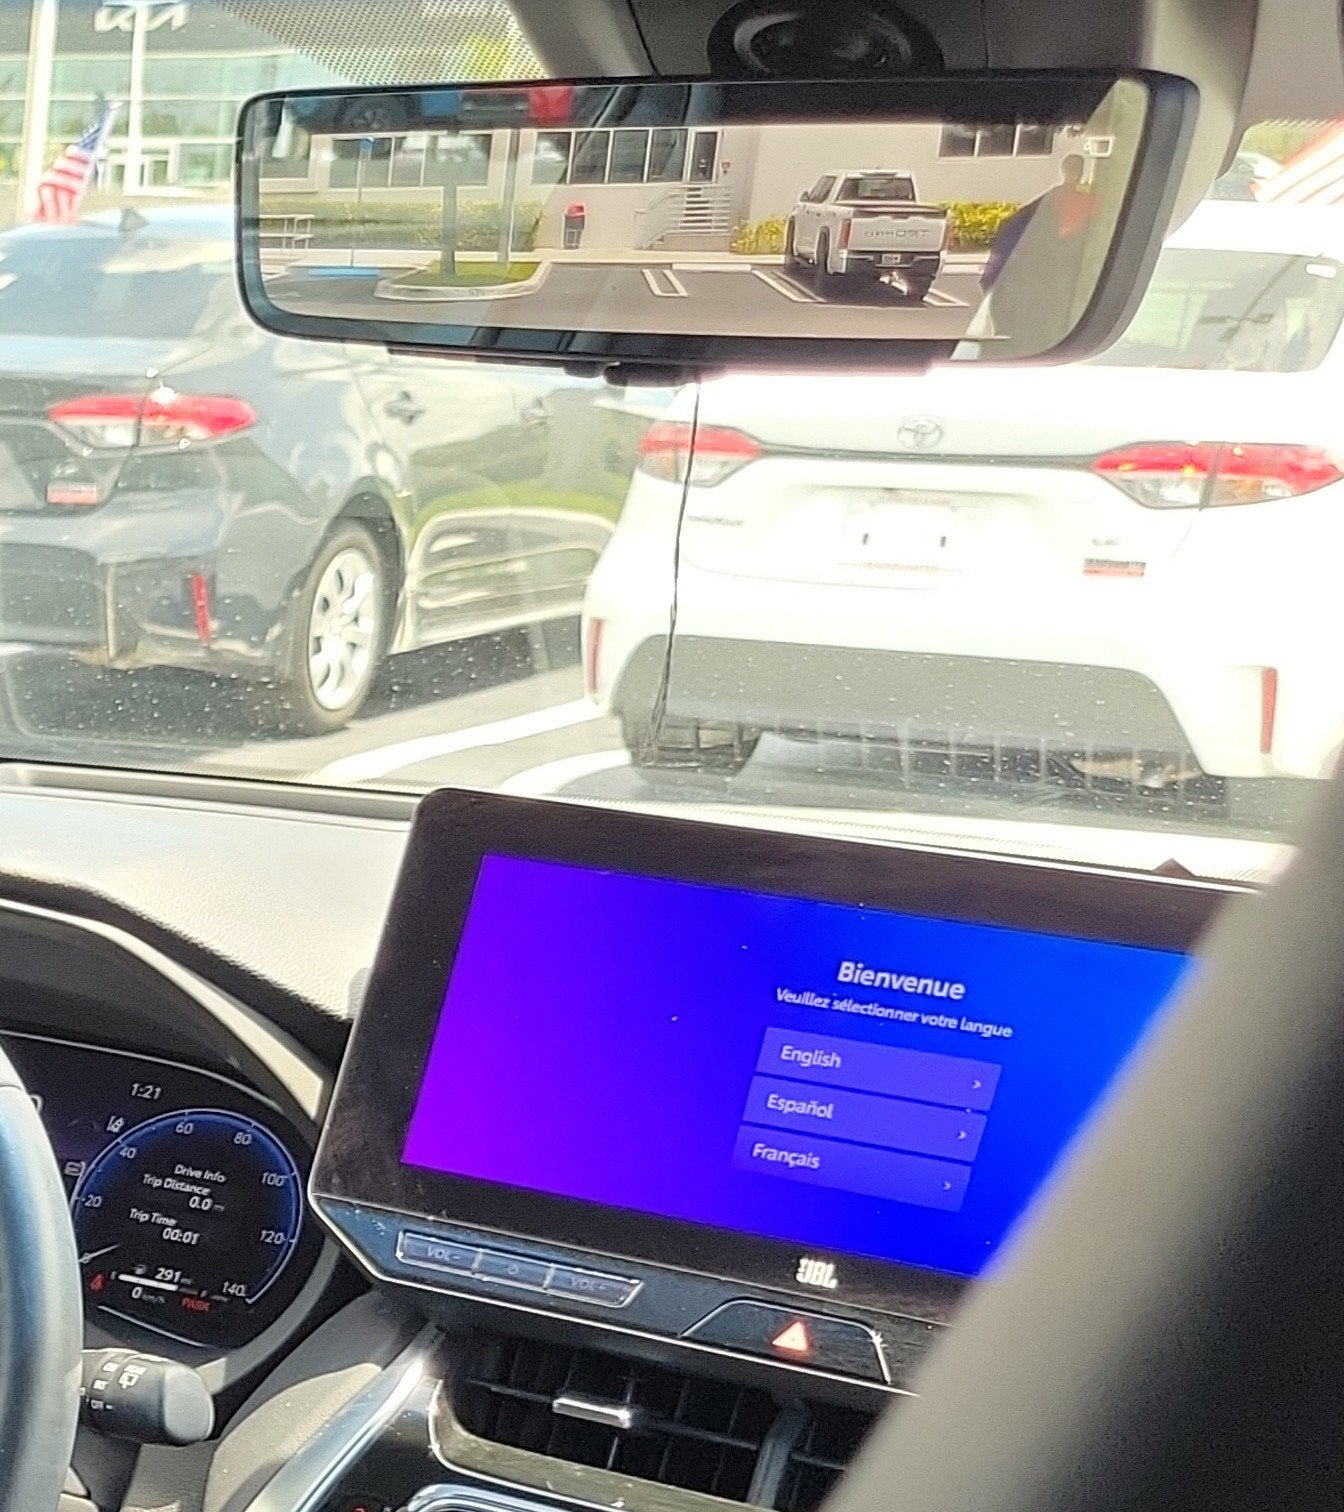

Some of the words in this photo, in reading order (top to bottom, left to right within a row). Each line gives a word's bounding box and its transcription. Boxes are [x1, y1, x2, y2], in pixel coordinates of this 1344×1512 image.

[837, 960, 967, 1001] Bienvenue
[776, 987, 830, 1010] Veuillez
[832, 995, 919, 1023] sélectionner
[920, 1012, 958, 1030] votre
[960, 1017, 1014, 1038] langue
[780, 1045, 842, 1069] English
[131, 1082, 161, 1100] 1:21
[766, 1093, 834, 1120] Español
[175, 1122, 194, 1135] 60
[233, 1131, 253, 1146] 80
[118, 1147, 137, 1160] 40
[752, 1143, 821, 1170] Français
[174, 1164, 202, 1179] Drive
[261, 1171, 285, 1187] 100
[142, 1173, 162, 1188] Trip
[163, 1178, 211, 1195] Distance
[84, 1194, 102, 1208] 20
[188, 1196, 212, 1211] 0.0
[129, 1208, 149, 1222] Trip
[150, 1212, 179, 1227] Time
[162, 1227, 200, 1245] 00:01
[260, 1229, 285, 1245] 120
[155, 1267, 182, 1283] 291
[795, 1257, 838, 1289] JBL
[131, 1286, 143, 1299] 0
[222, 1281, 246, 1297] 140
